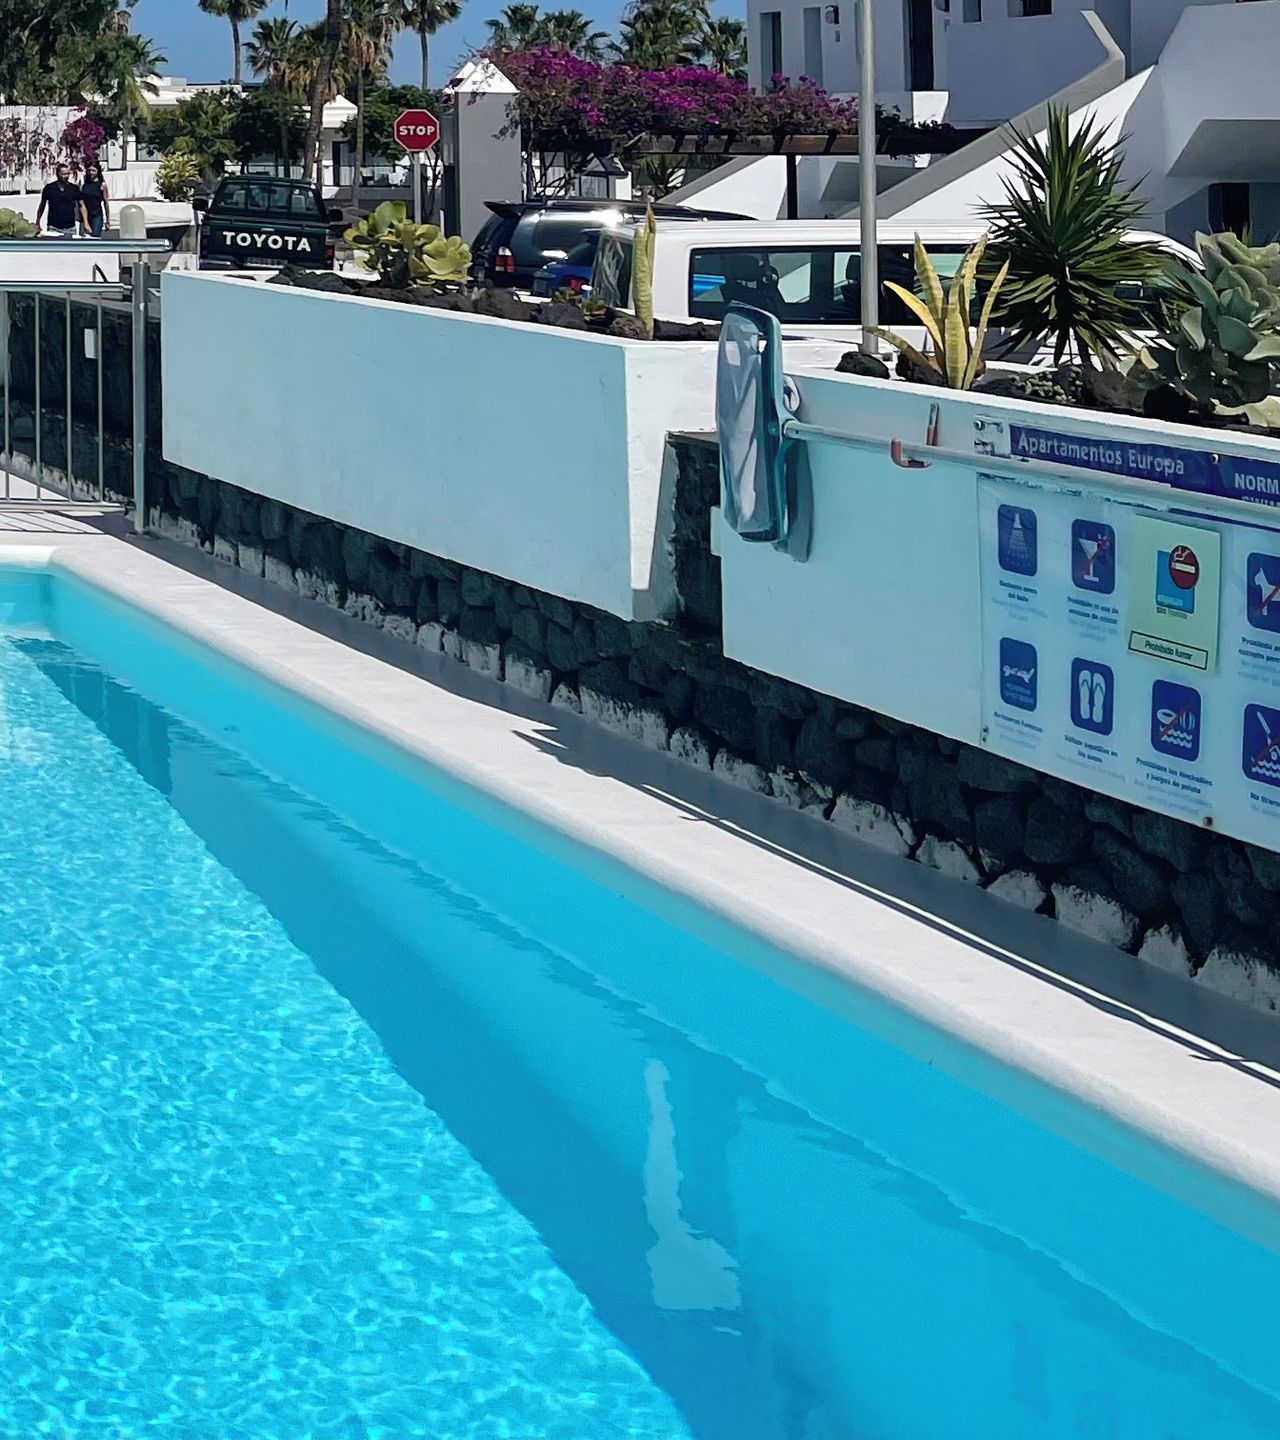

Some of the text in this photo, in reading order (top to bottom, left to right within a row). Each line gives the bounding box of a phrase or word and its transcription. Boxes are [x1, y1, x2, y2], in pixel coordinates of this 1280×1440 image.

[398, 125, 435, 136] STOP
[222, 231, 312, 253] TOYOTA
[1018, 431, 1184, 478] Apartamentos Europa
